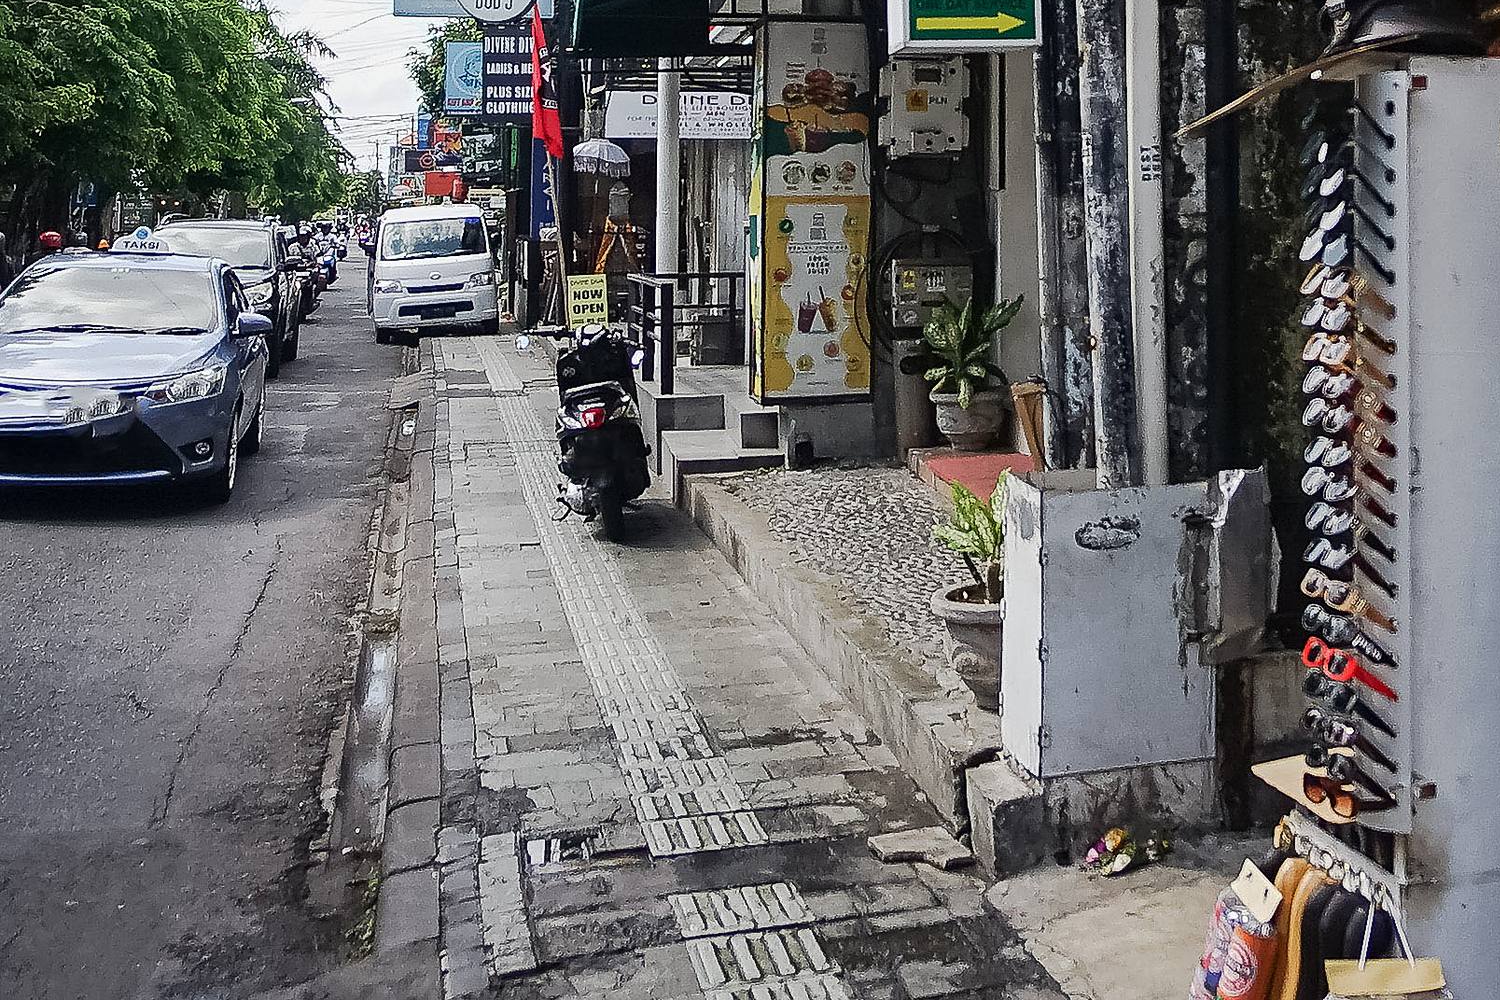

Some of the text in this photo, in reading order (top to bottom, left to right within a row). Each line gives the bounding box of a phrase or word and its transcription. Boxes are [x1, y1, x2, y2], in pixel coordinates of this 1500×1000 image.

[518, 36, 535, 54] DIV
[486, 62, 513, 75] LADIES
[521, 62, 534, 75] ME
[486, 85, 512, 99] PLUS
[123, 240, 160, 250] TAKSI
[573, 288, 603, 301] NOW
[572, 302, 605, 315] OPEN
